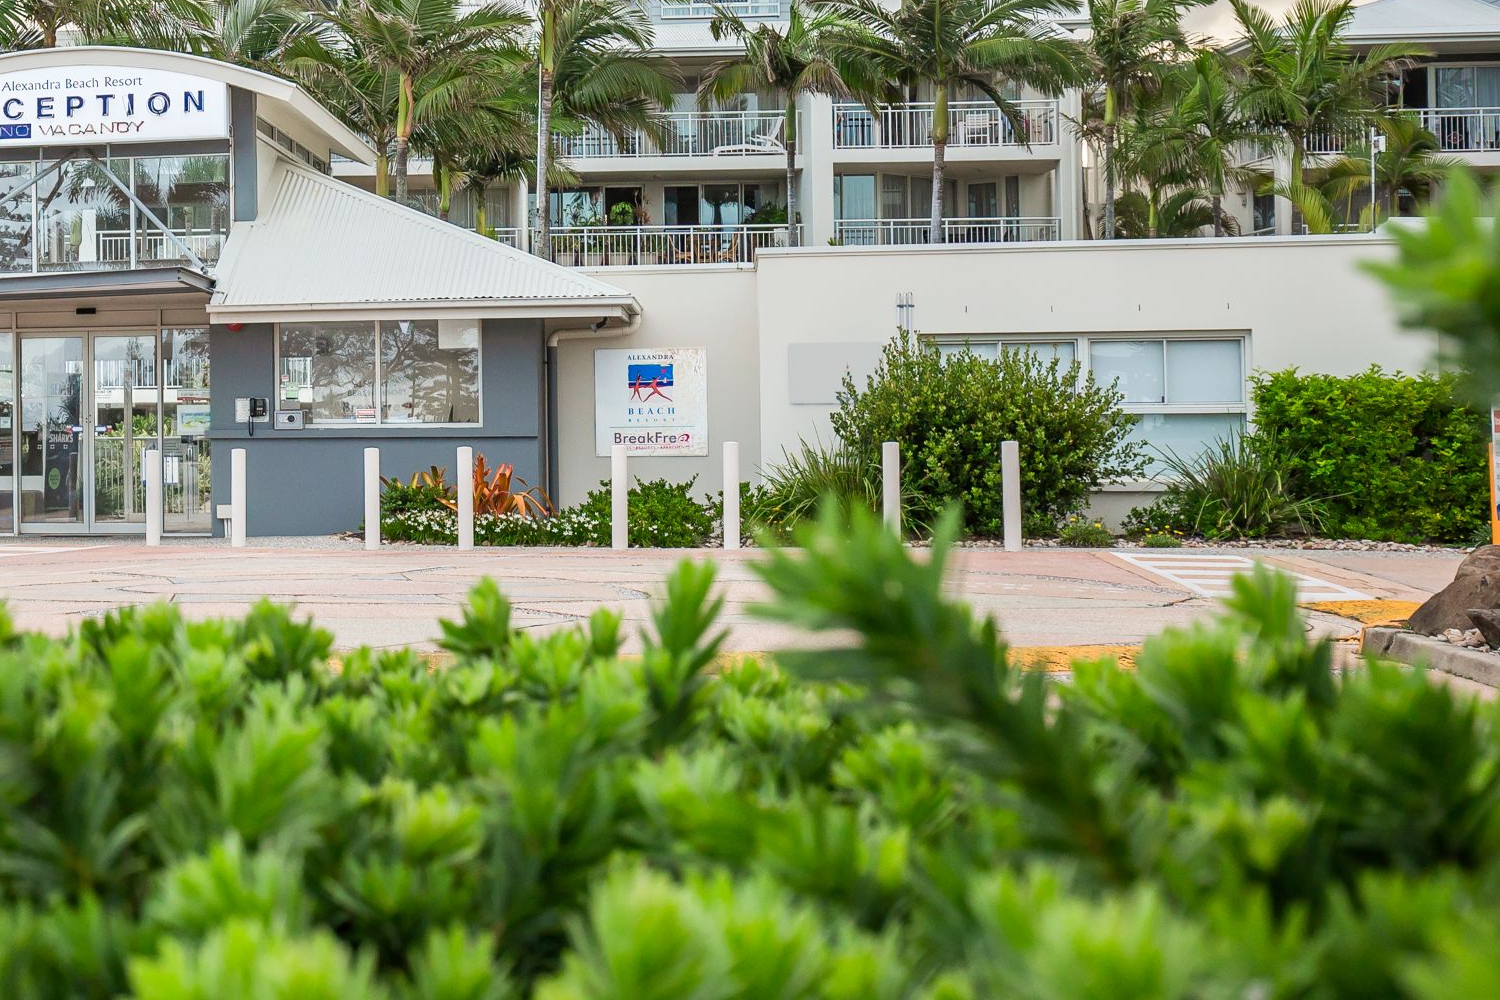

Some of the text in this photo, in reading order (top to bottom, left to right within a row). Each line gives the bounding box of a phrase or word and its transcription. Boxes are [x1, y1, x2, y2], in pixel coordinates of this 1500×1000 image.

[1, 75, 144, 92] Alexandra Beach Resort
[0, 123, 31, 139] NO
[628, 407, 675, 415] BEACH
